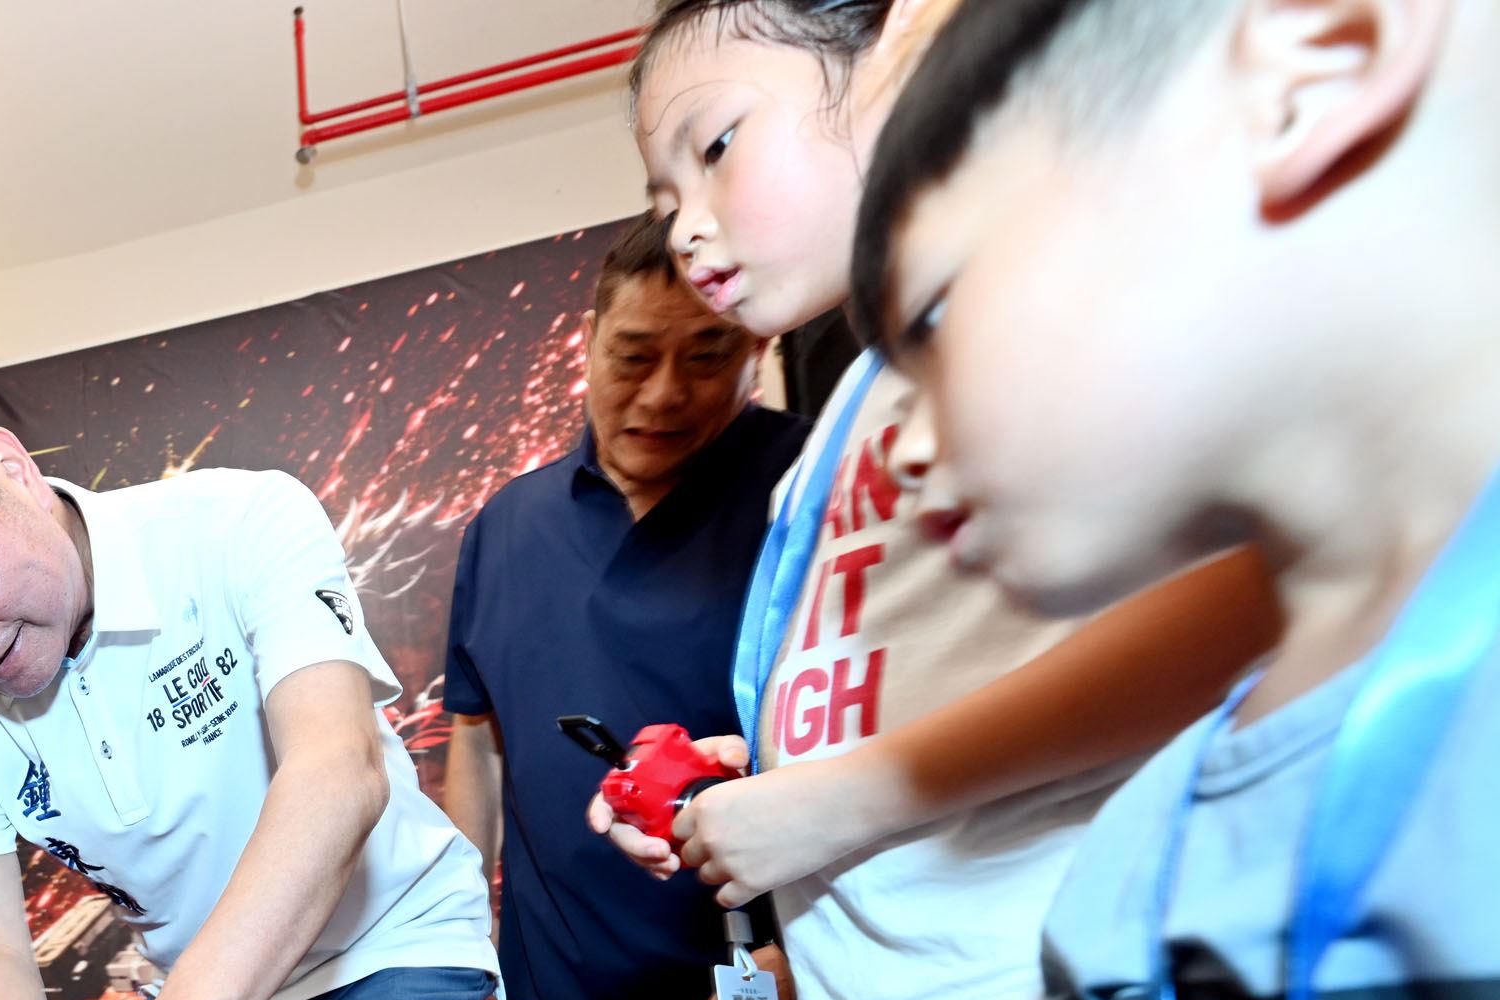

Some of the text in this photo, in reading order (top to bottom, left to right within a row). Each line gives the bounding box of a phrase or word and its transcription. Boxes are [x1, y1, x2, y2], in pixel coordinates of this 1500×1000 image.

[215, 647, 238, 676] 82
[163, 656, 210, 704] LE COQ
[172, 677, 224, 729] SPORTIF
[146, 707, 166, 732] 18
[202, 727, 223, 745] FRANCE
